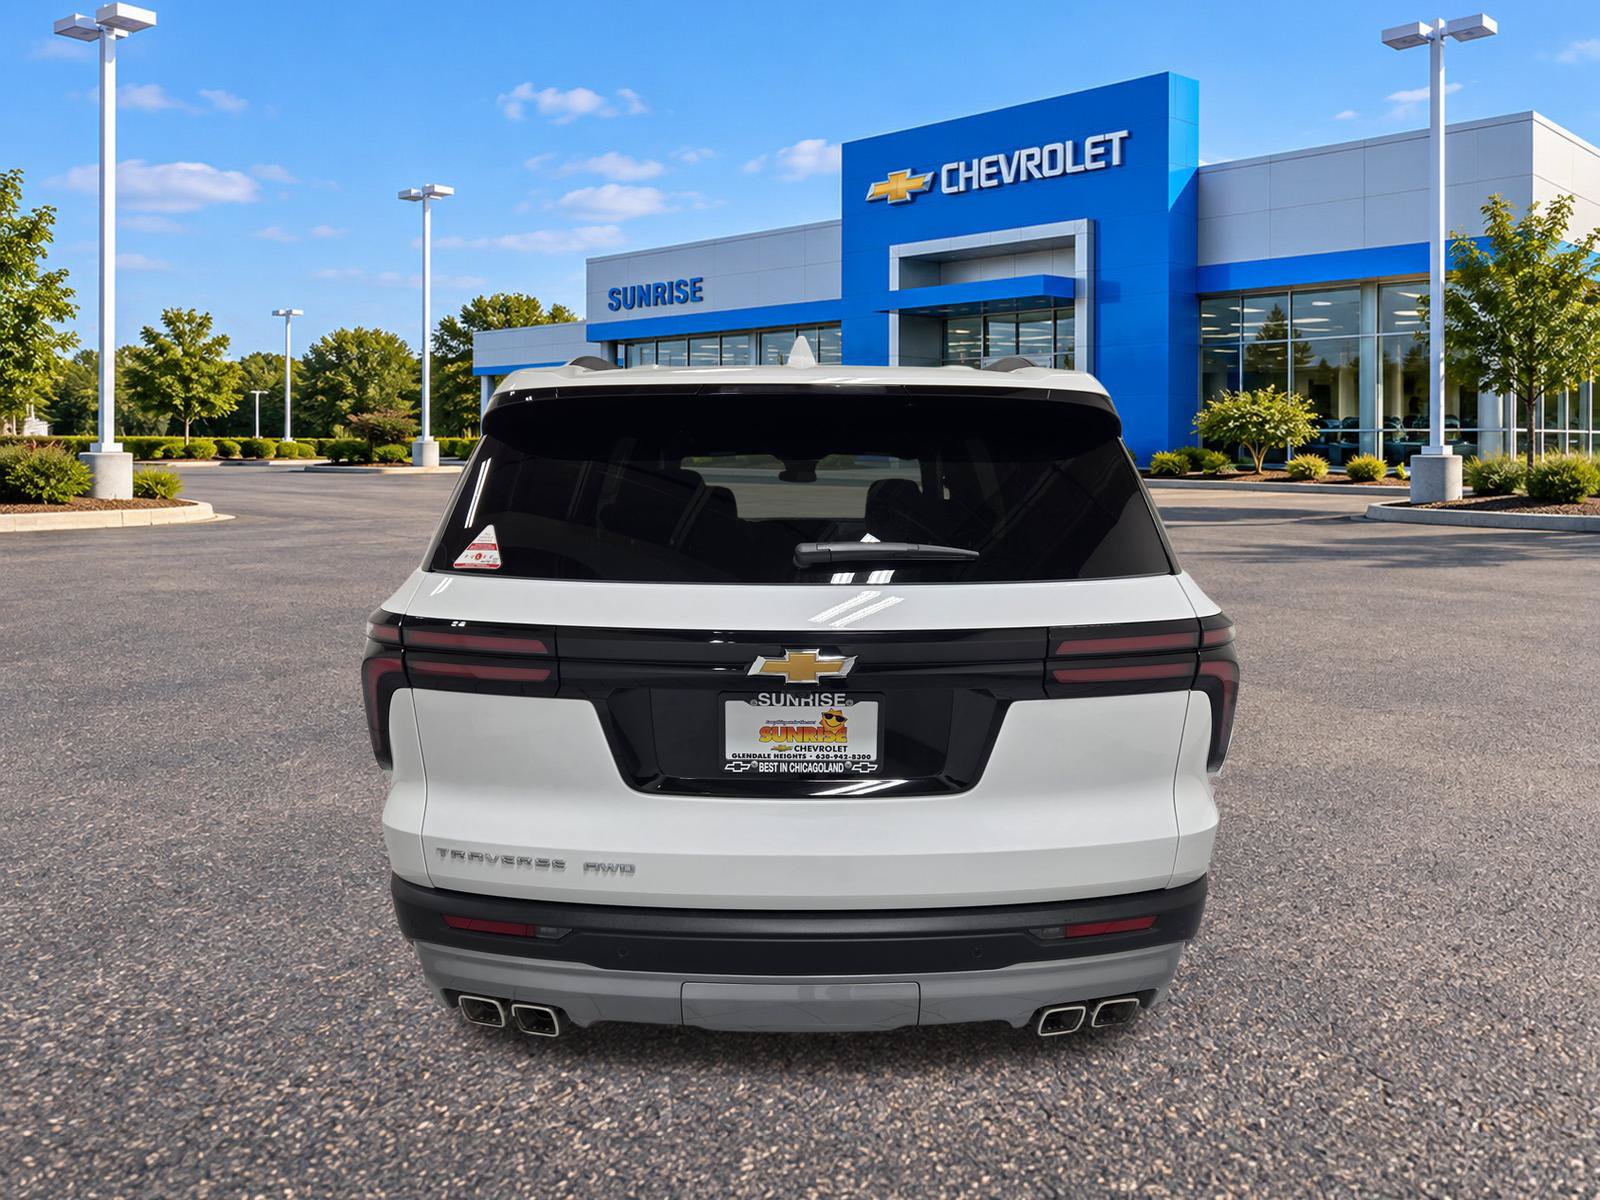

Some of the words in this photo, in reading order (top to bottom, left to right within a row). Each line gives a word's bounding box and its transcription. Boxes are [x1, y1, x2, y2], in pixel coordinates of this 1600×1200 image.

[940, 130, 1129, 194] CHEVROLET
[607, 277, 704, 312] SUNRISE
[759, 726, 848, 743] SUNRISE
[794, 745, 848, 753] CHEVROLET
[759, 762, 778, 773] BEST
[779, 762, 788, 773] IN
[789, 762, 844, 773] CHICAGOLAND
[436, 847, 566, 870] TRAVERSE
[582, 861, 636, 873] AWD
